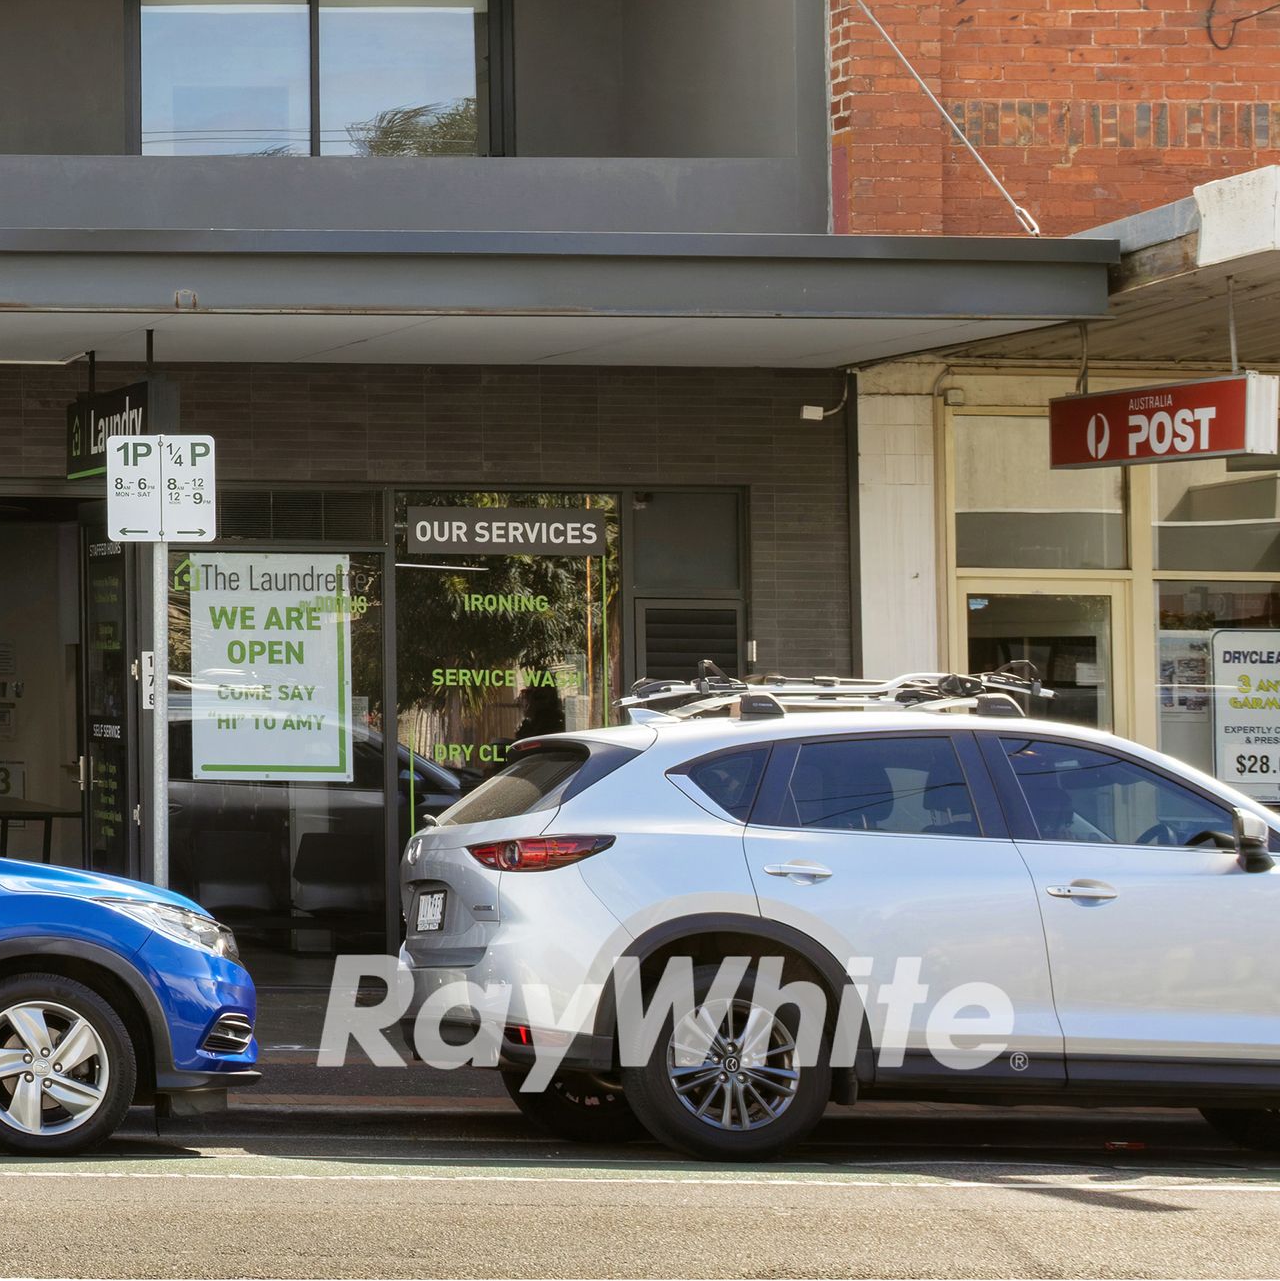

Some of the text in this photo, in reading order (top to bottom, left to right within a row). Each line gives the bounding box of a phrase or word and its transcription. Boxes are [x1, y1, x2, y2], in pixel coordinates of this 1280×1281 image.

[1128, 394, 1173, 411] AUSTRALIA
[91, 396, 143, 455] Laundry
[1128, 406, 1216, 456] POST
[116, 442, 152, 467] 1P
[190, 442, 210, 467] P
[415, 520, 598, 545] OUR SERVICES
[201, 564, 240, 591] The
[464, 594, 549, 613] IRONING
[209, 606, 322, 631] WE ARE
[227, 640, 305, 665] OPEN
[432, 669, 582, 688] SERVICE WASH
[1237, 674, 1252, 694] 3
[217, 684, 316, 701] COME SAY
[103, 725, 121, 739] SERVICE
[251, 714, 277, 730] TO
[281, 714, 326, 731] AMY
[1225, 726, 1271, 734] EXPERTLY
[434, 743, 474, 763] DRY
[1236, 754, 1280, 776] $28.
